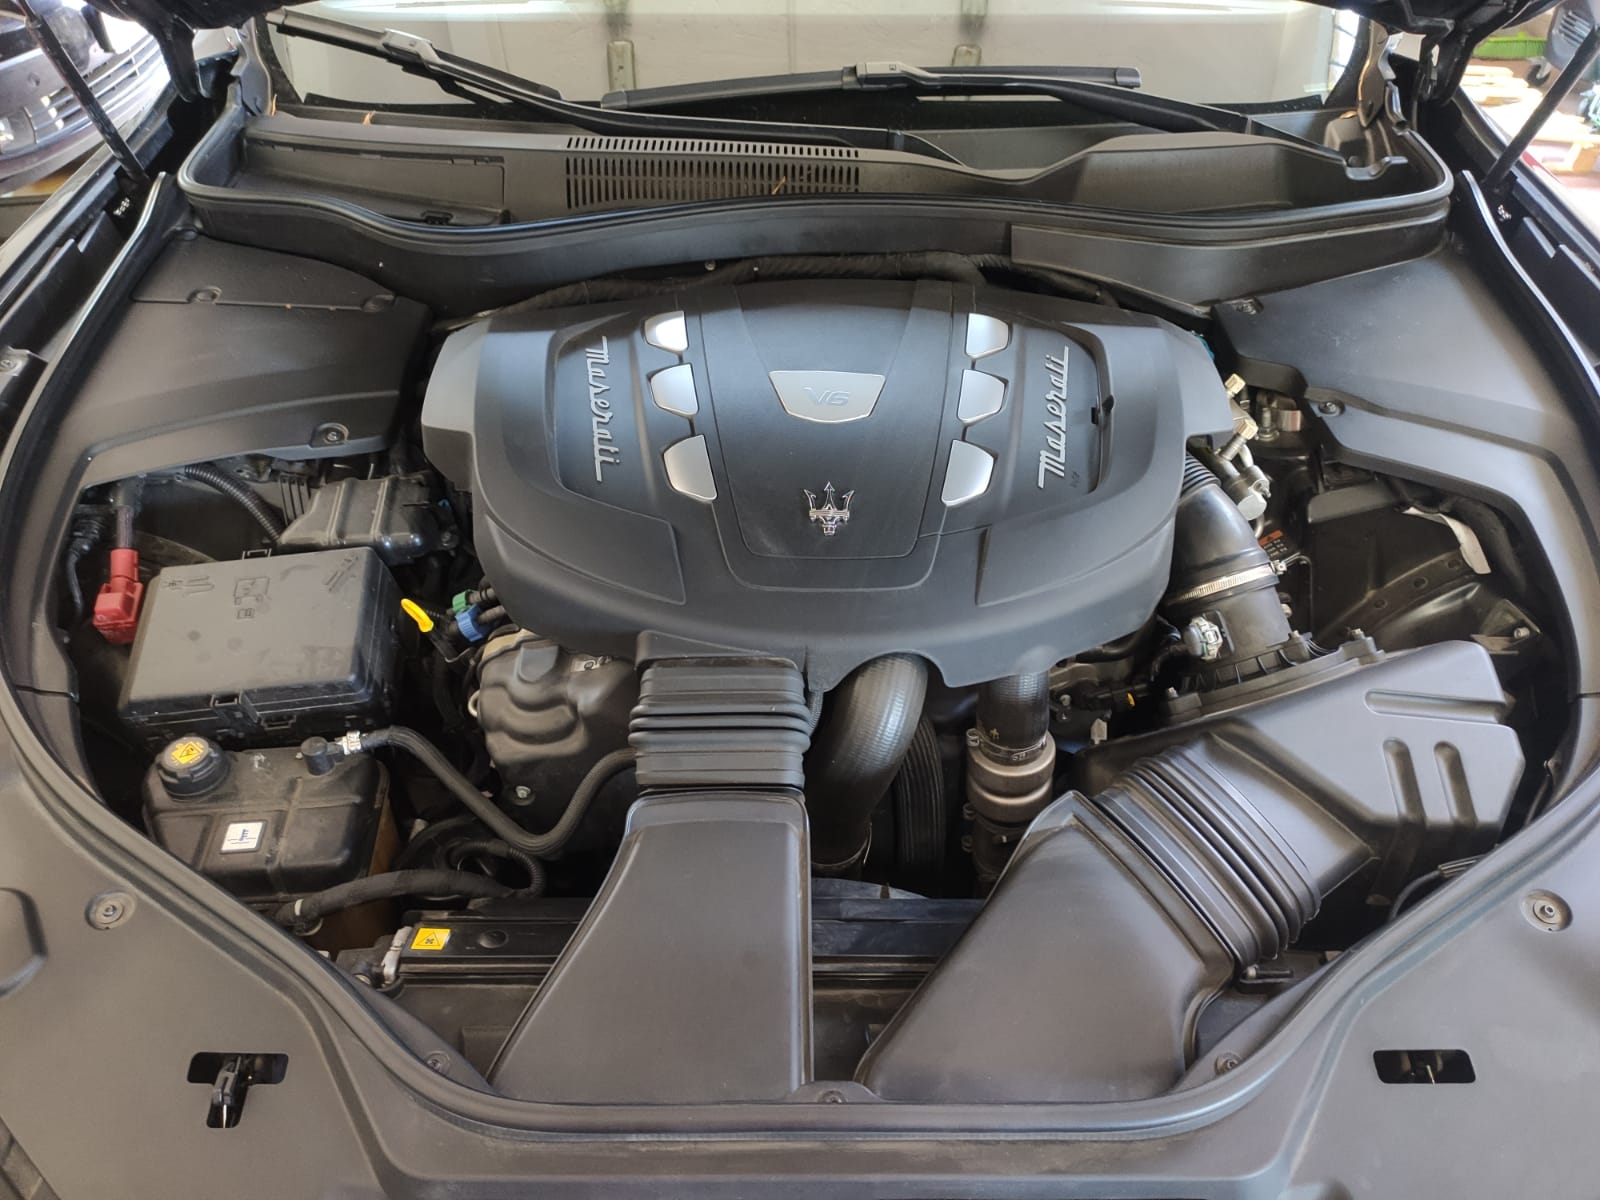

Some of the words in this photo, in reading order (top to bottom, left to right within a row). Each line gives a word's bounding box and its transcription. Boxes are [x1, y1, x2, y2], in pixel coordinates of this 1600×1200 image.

[585, 335, 620, 482] Maserati
[802, 386, 850, 407] V6
[1037, 345, 1069, 489] Maserati
